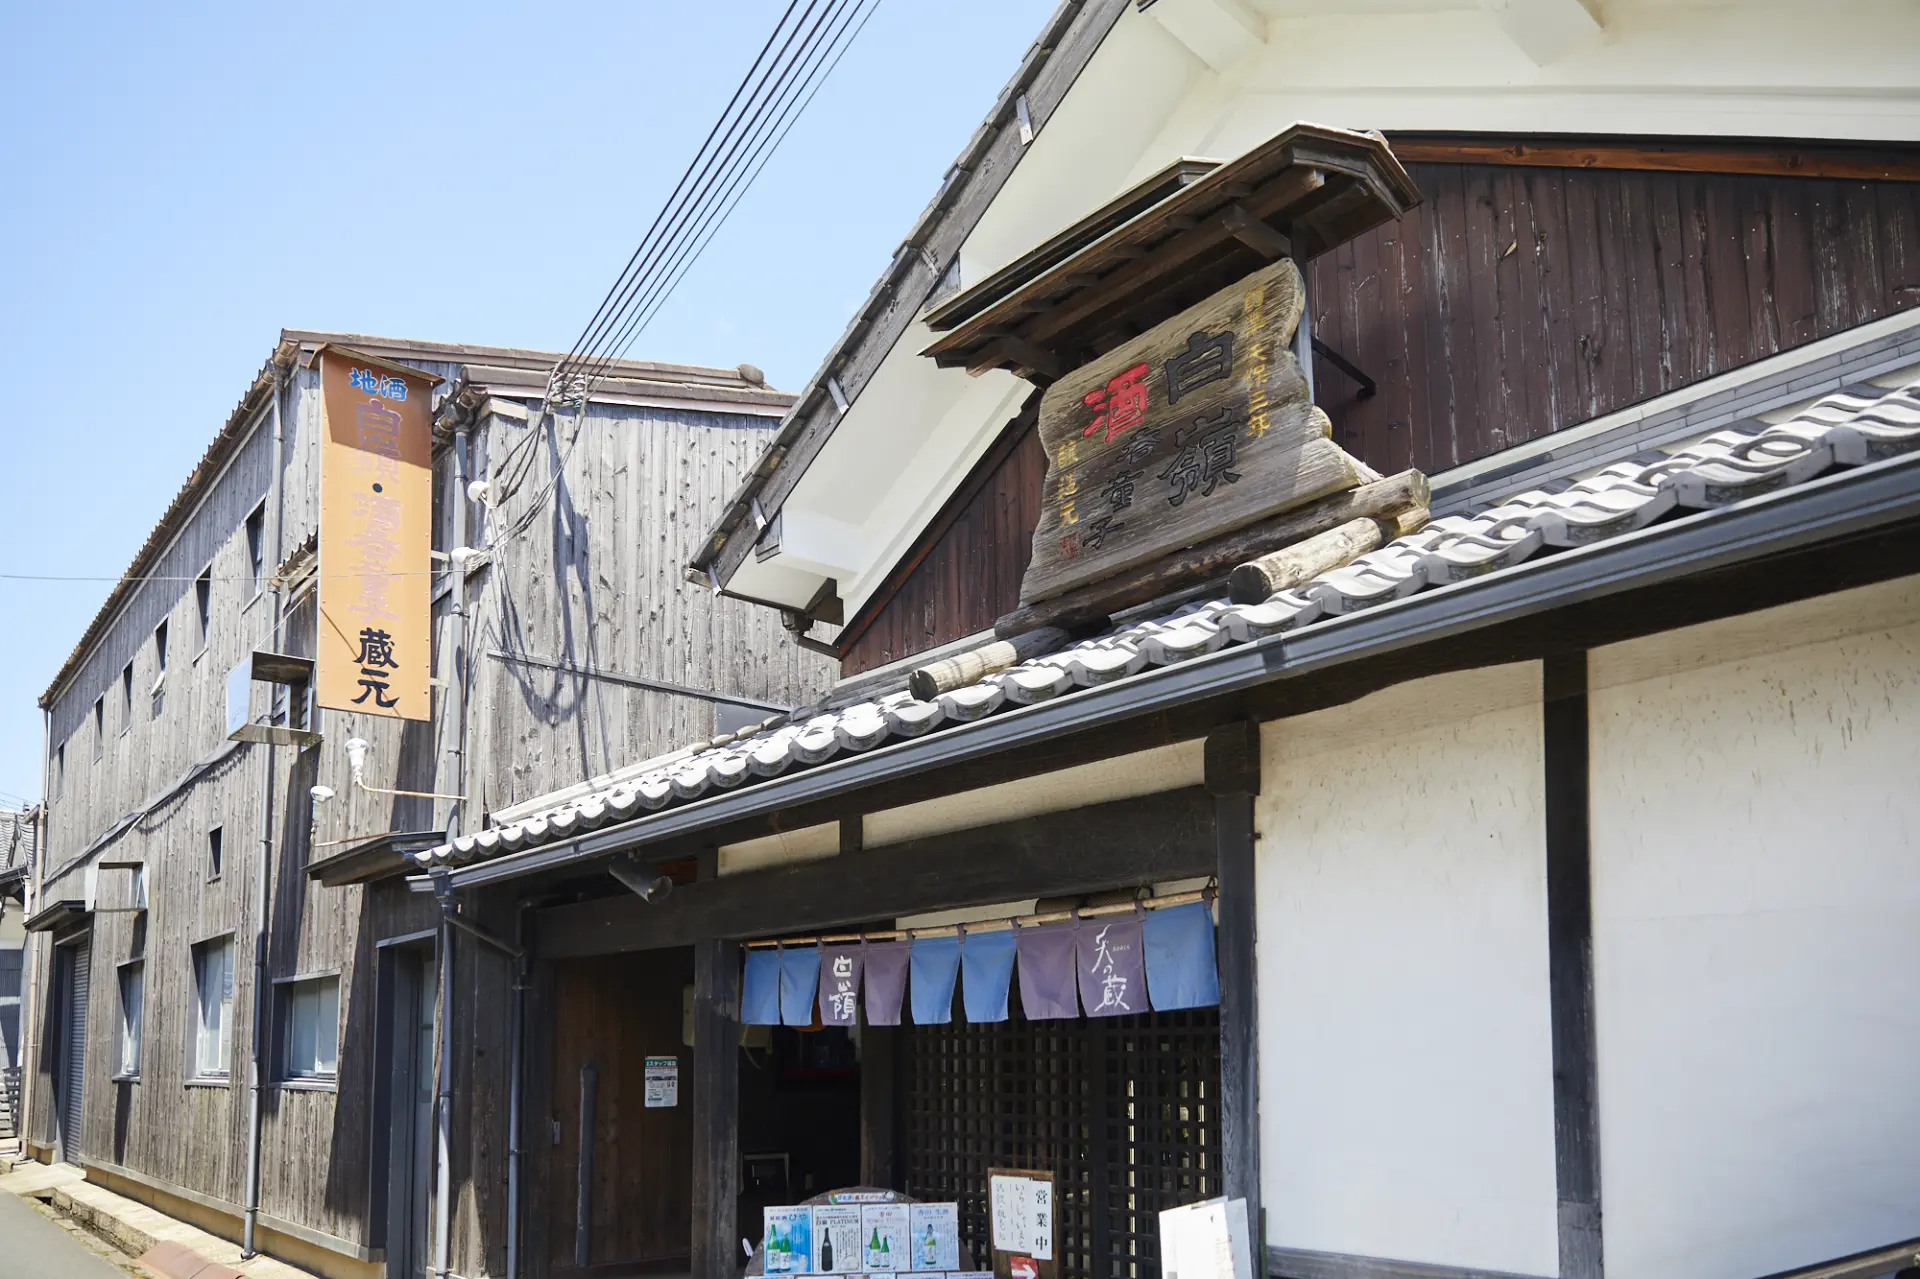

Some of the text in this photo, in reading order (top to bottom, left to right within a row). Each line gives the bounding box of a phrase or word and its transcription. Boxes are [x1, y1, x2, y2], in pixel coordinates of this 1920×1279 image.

[348, 366, 408, 402] 地酒
[1035, 1189, 1048, 1251] 営業中
